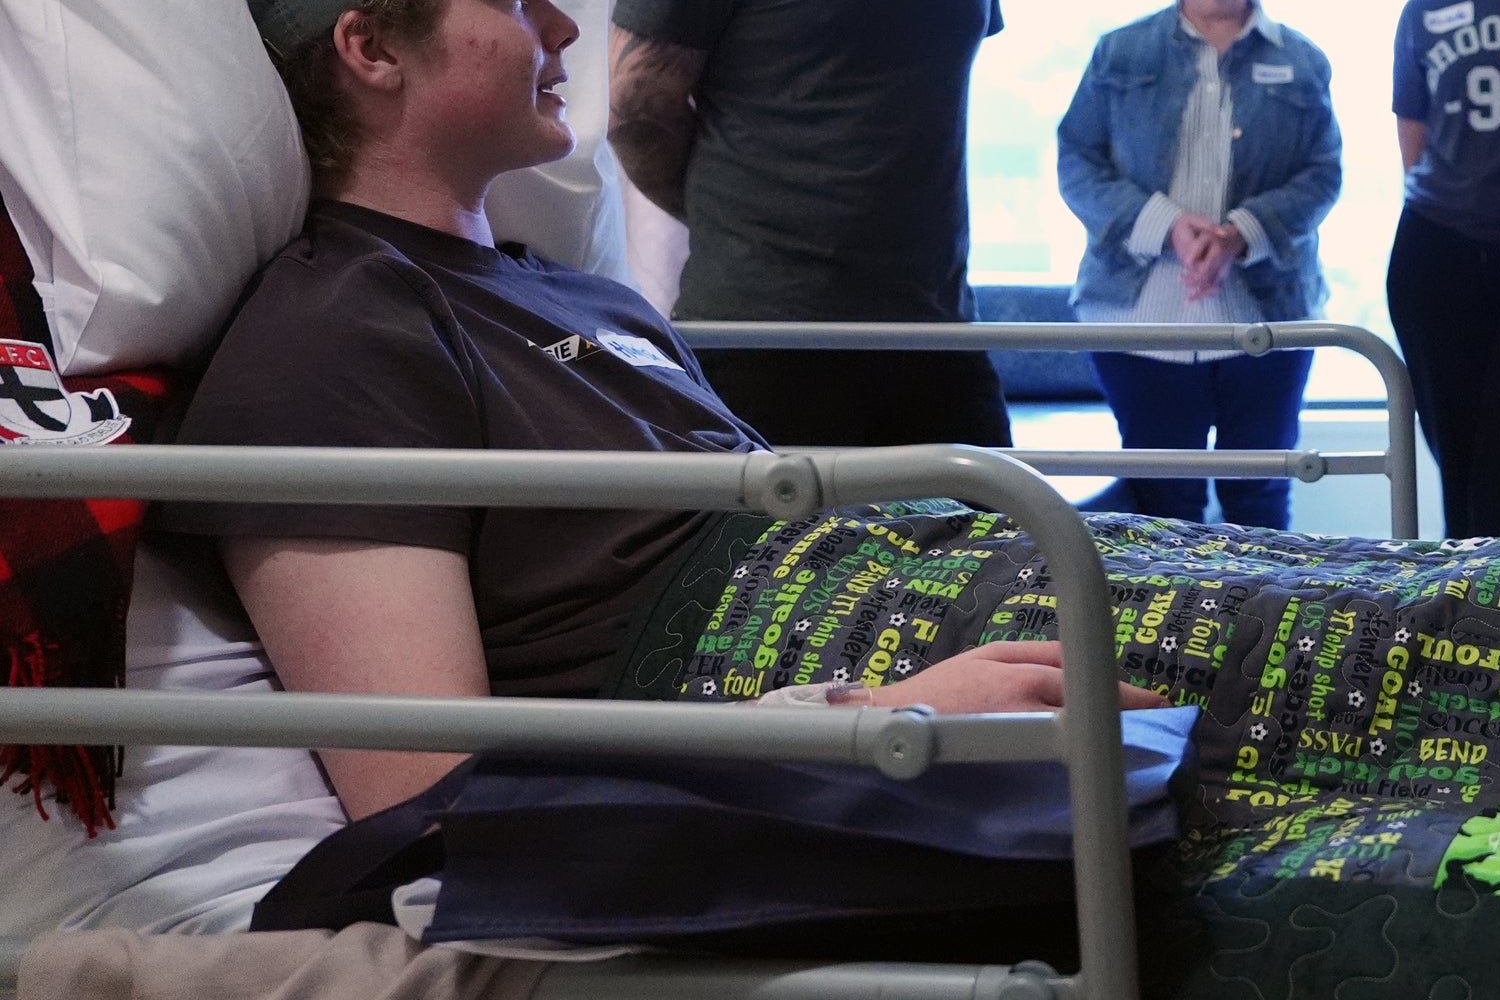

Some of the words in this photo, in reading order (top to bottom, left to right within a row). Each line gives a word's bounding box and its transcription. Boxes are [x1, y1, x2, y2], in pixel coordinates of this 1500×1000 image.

[707, 584, 738, 631] score
[753, 569, 816, 670] goalie
[1134, 589, 1177, 645] GOAL
[1166, 586, 1203, 634] Defender
[732, 615, 763, 661] BEND
[806, 616, 841, 648] chip
[1183, 617, 1222, 659] foul
[1313, 632, 1346, 670] chip
[723, 667, 766, 698] foul
[1305, 672, 1337, 721] shot
[1368, 645, 1410, 737] GOAL
[1297, 727, 1365, 758] PASS
[1418, 738, 1488, 765] BEND
